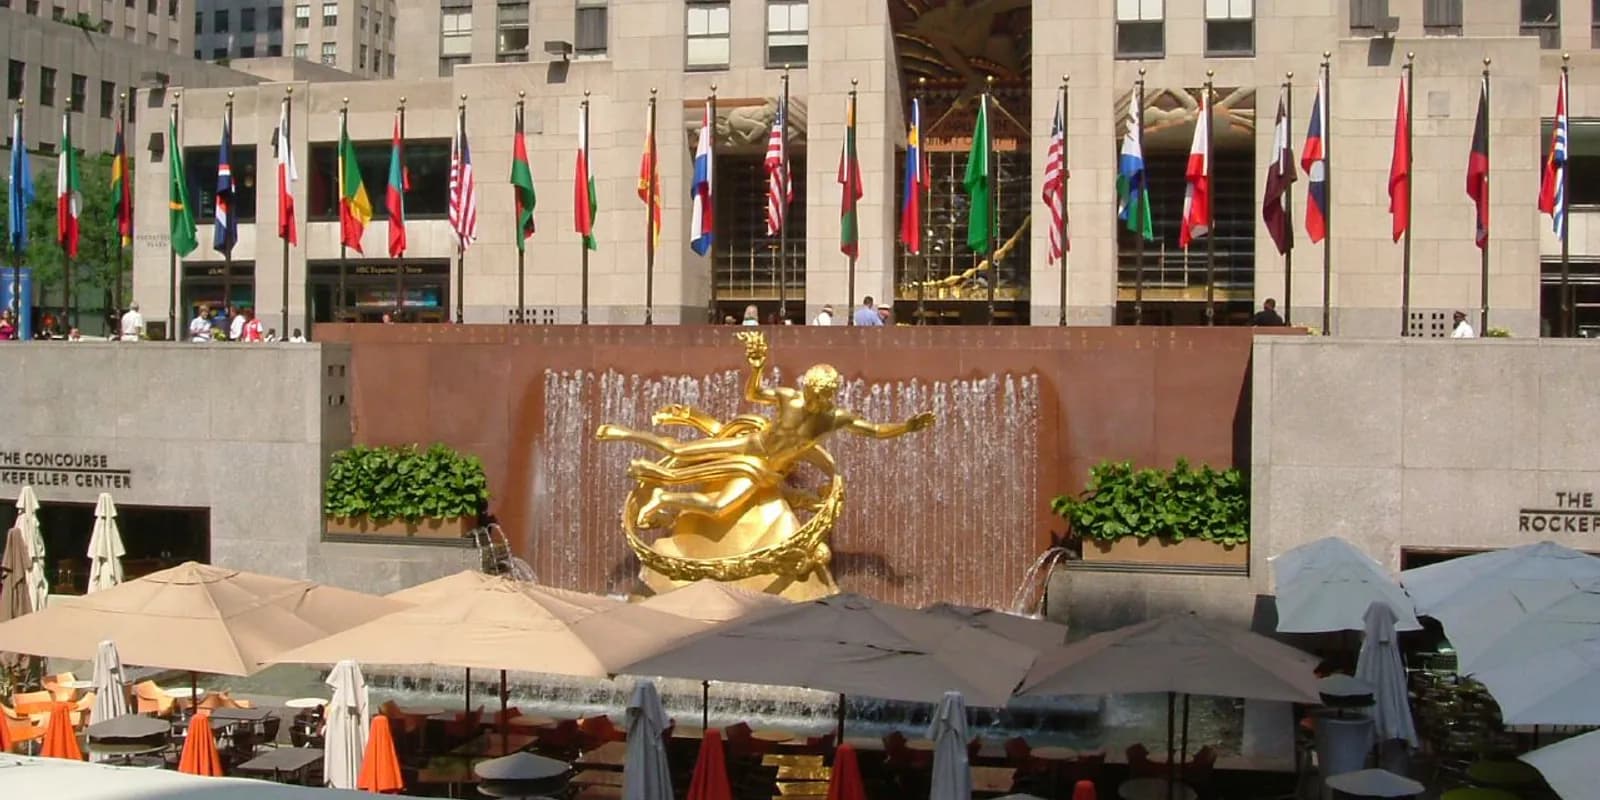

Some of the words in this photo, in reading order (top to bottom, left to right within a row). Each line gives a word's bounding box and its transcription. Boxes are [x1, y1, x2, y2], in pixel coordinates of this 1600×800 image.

[25, 452, 107, 468] CONCOURSE
[1, 471, 69, 486] KEFELLER
[75, 474, 131, 489] CENTER
[1556, 492, 1592, 507] THE
